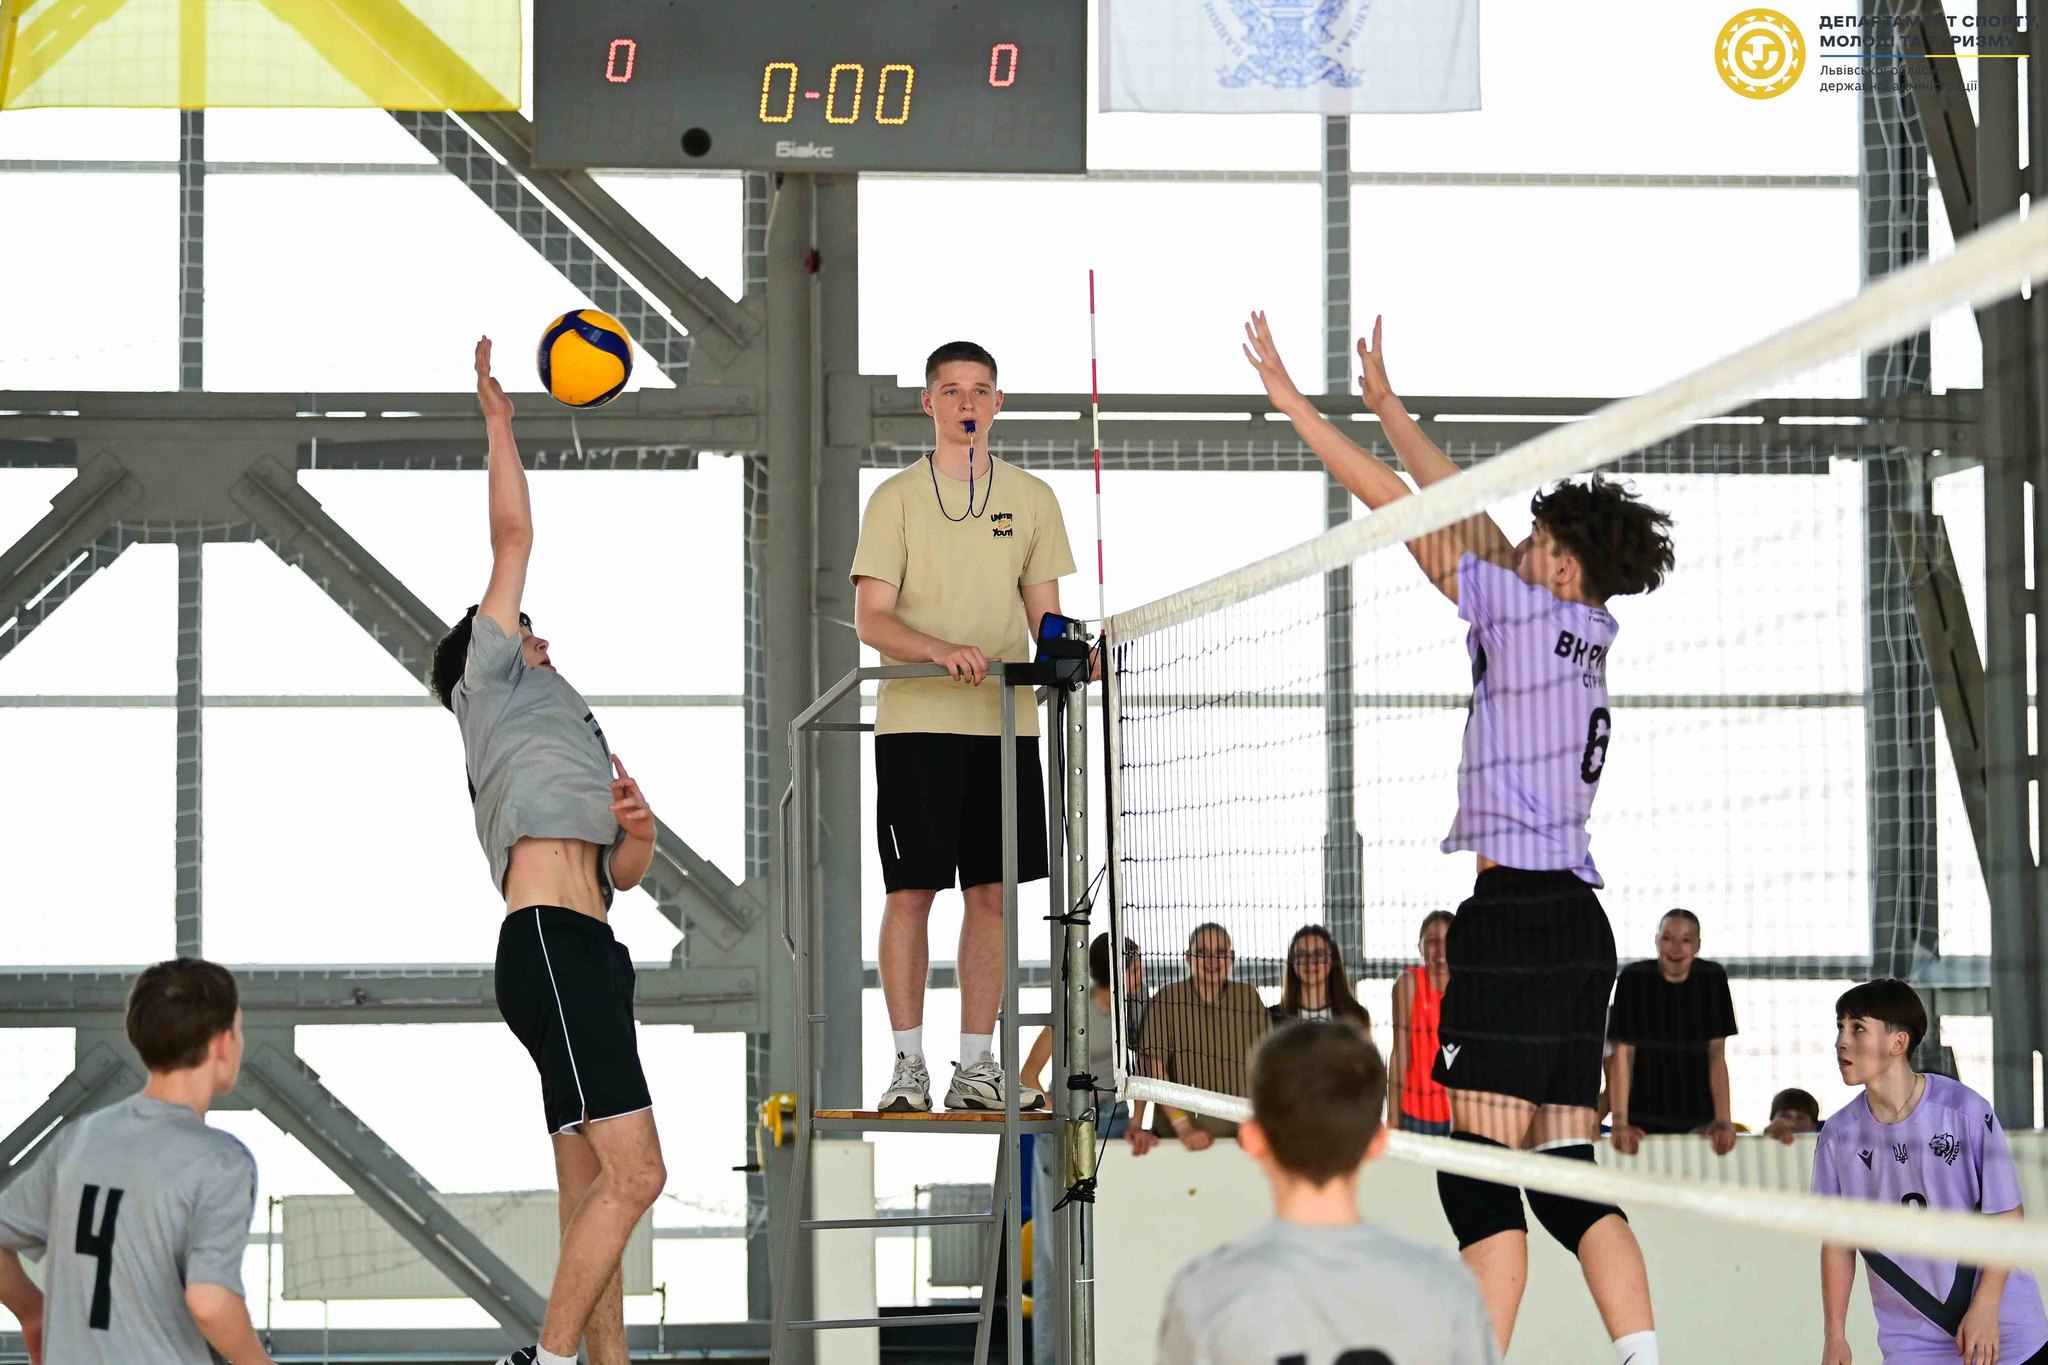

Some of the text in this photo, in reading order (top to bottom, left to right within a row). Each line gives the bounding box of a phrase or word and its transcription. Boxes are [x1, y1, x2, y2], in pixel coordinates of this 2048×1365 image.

[606, 38, 636, 83] 0
[989, 43, 1018, 86] 0
[1581, 707, 1612, 785] 6
[75, 1183, 125, 1332] 4
